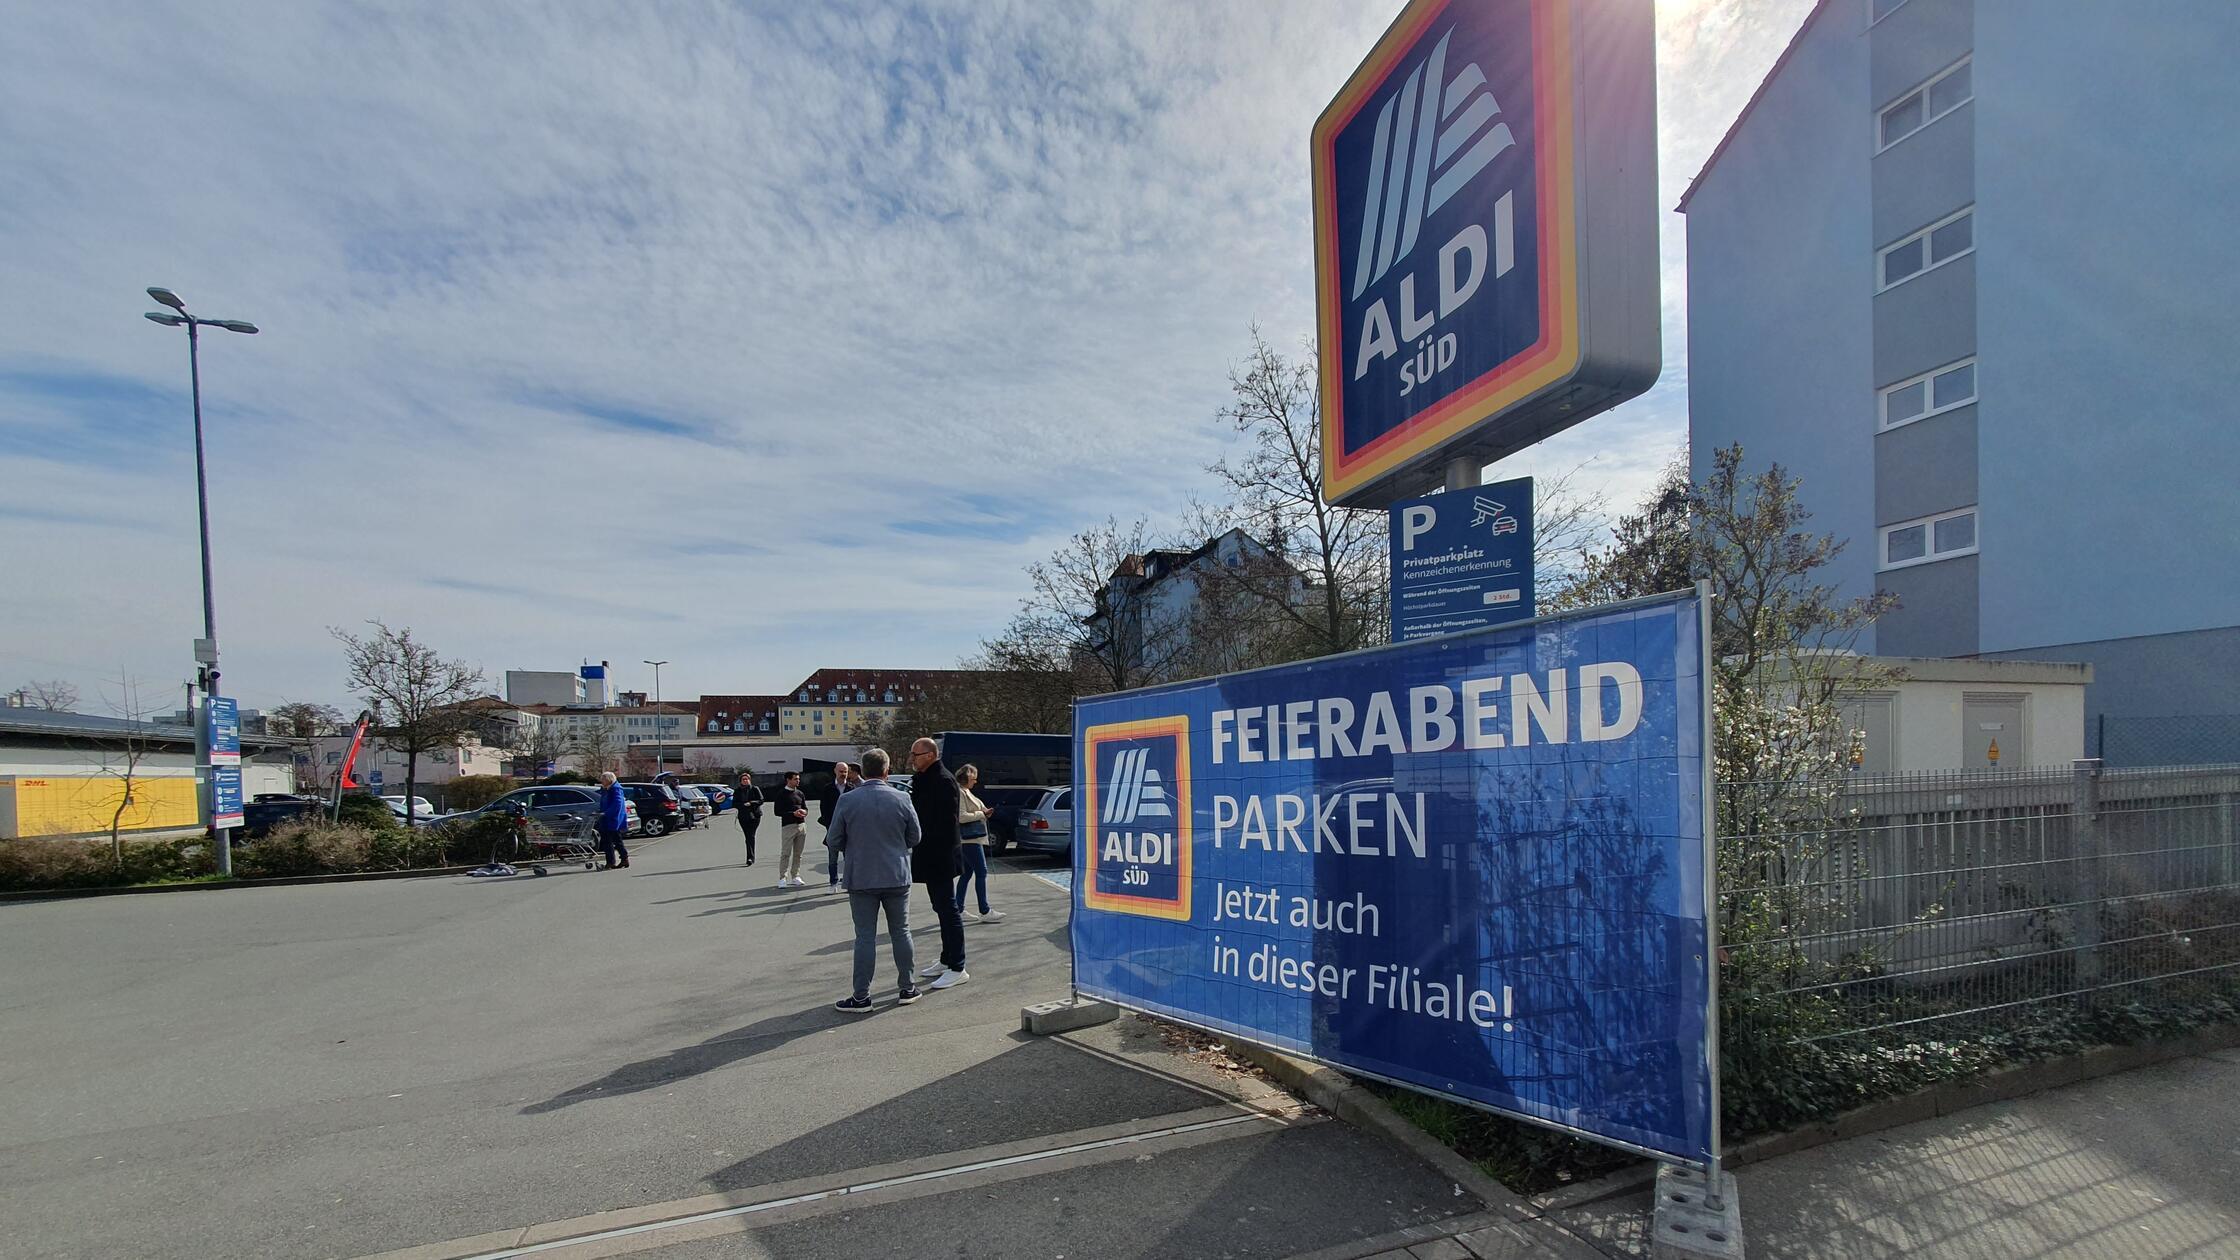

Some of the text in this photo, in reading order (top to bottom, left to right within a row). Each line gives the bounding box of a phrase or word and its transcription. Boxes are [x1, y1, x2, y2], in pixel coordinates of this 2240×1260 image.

[1355, 189, 1515, 381] ALDI
[1400, 333, 1457, 397] SÜD
[1403, 505, 1437, 551] P
[1403, 546, 1484, 568] Privatparkplatz
[1403, 558, 1512, 580] Kennzeichenerkennung
[1403, 591, 1427, 599] Während
[1211, 662, 1644, 764] FEIERABEND
[1103, 832, 1171, 865] ALDI
[1213, 793, 1426, 858] PARKEN
[1122, 865, 1149, 886] SÜD
[1214, 882, 1379, 937] Jetzt auch
[1213, 935, 1514, 1033] in dieser Filiale!
